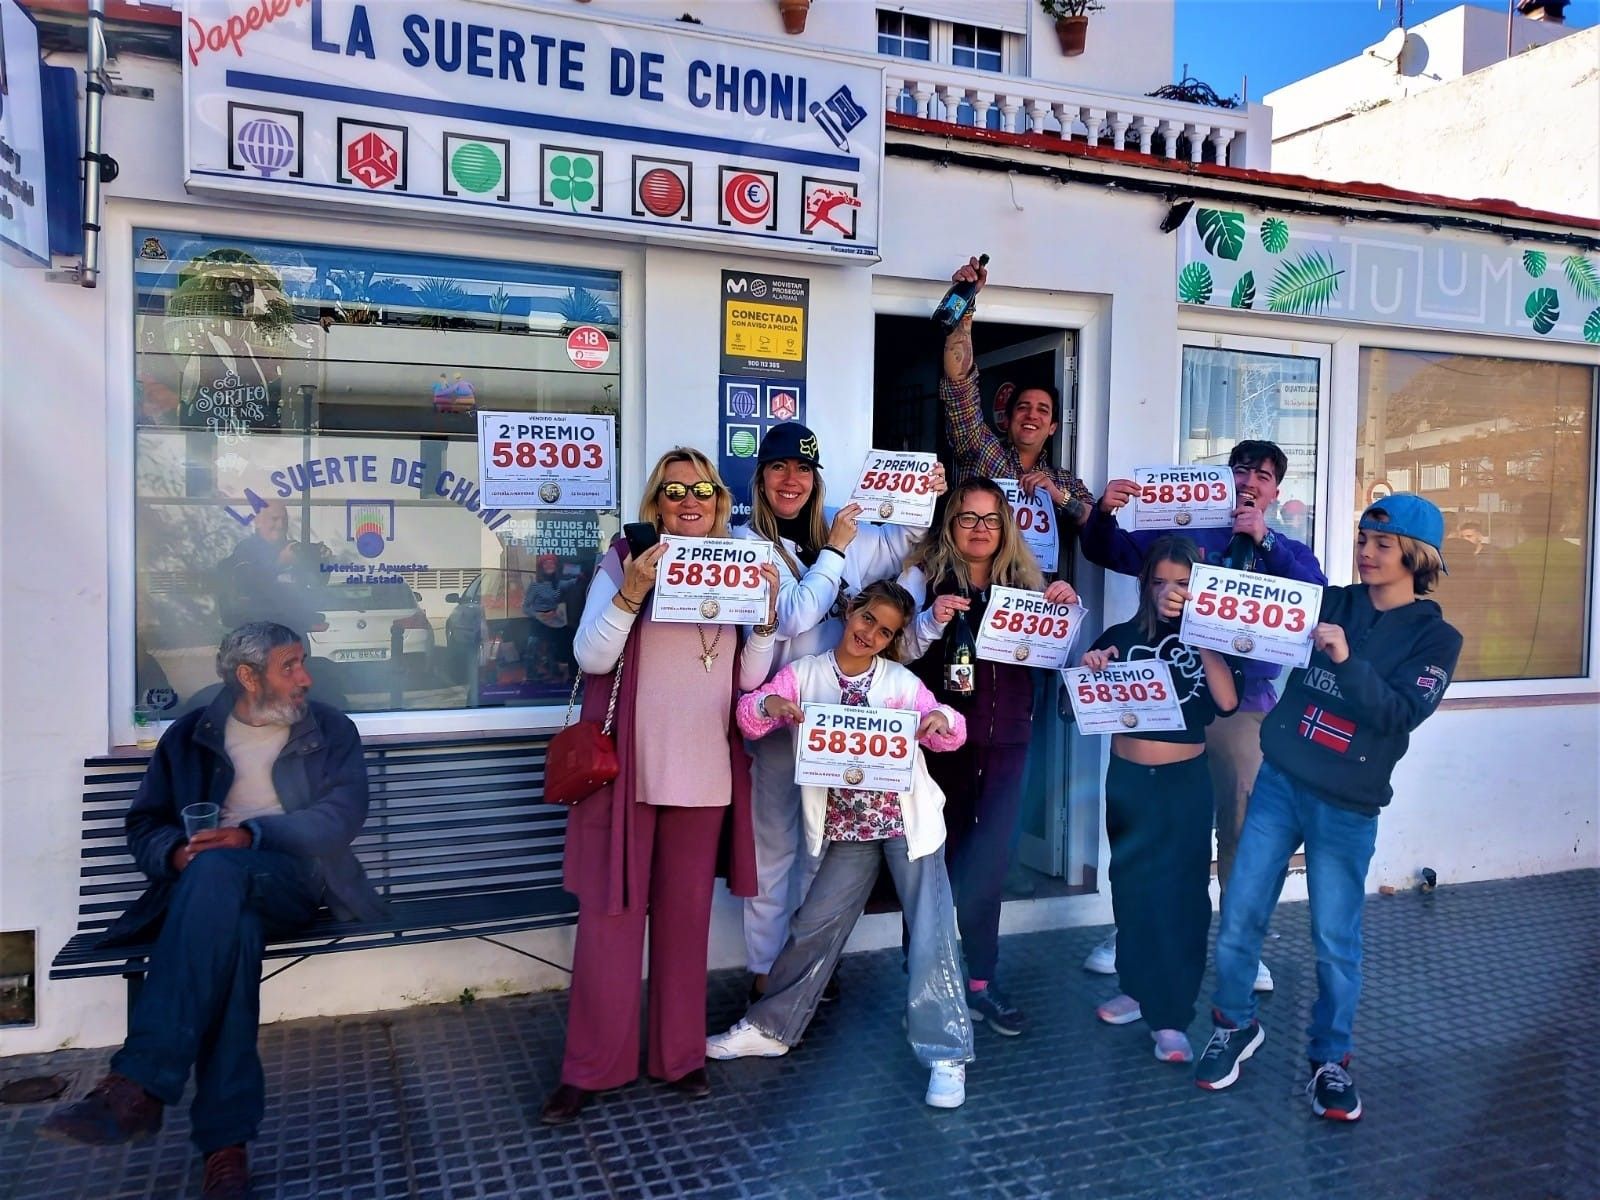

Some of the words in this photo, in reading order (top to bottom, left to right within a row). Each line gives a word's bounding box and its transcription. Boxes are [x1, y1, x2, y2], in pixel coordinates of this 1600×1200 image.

[311, 0, 375, 59] LA
[402, 14, 584, 92] SUERTE
[610, 47, 664, 102] DE
[687, 59, 806, 123] CHONI
[772, 280, 802, 290] MOVISTAR
[772, 287, 805, 297] PROSEGUR
[731, 309, 798, 325] CONECTADA
[747, 321, 767, 329] AVISO
[196, 386, 265, 412] SORTEO
[213, 406, 236, 420] QUE
[240, 402, 264, 421] NOS
[518, 424, 595, 441] PREMIO
[492, 442, 603, 469] 58303
[883, 459, 930, 473] PREMIO
[860, 471, 930, 495] 58303
[1160, 471, 1220, 483] PREMIO
[224, 487, 269, 527] LA
[270, 456, 378, 498] SUERTE
[390, 457, 427, 489] DE
[1141, 482, 1227, 504] 58303
[691, 547, 756, 563] PREMIO
[319, 562, 366, 574] Loterías
[378, 562, 429, 575] Apuestas
[666, 563, 760, 589] 58303
[346, 574, 364, 584] del
[366, 574, 405, 585] Estado
[1224, 579, 1302, 605] PREMIO
[1015, 598, 1069, 617] PREMIO
[1195, 592, 1306, 633] 58303
[990, 609, 1069, 639] 58303
[1093, 668, 1155, 682] PREMIO
[1077, 681, 1167, 704] 58303
[832, 714, 903, 733] PREMIO
[807, 729, 908, 759] 58303
